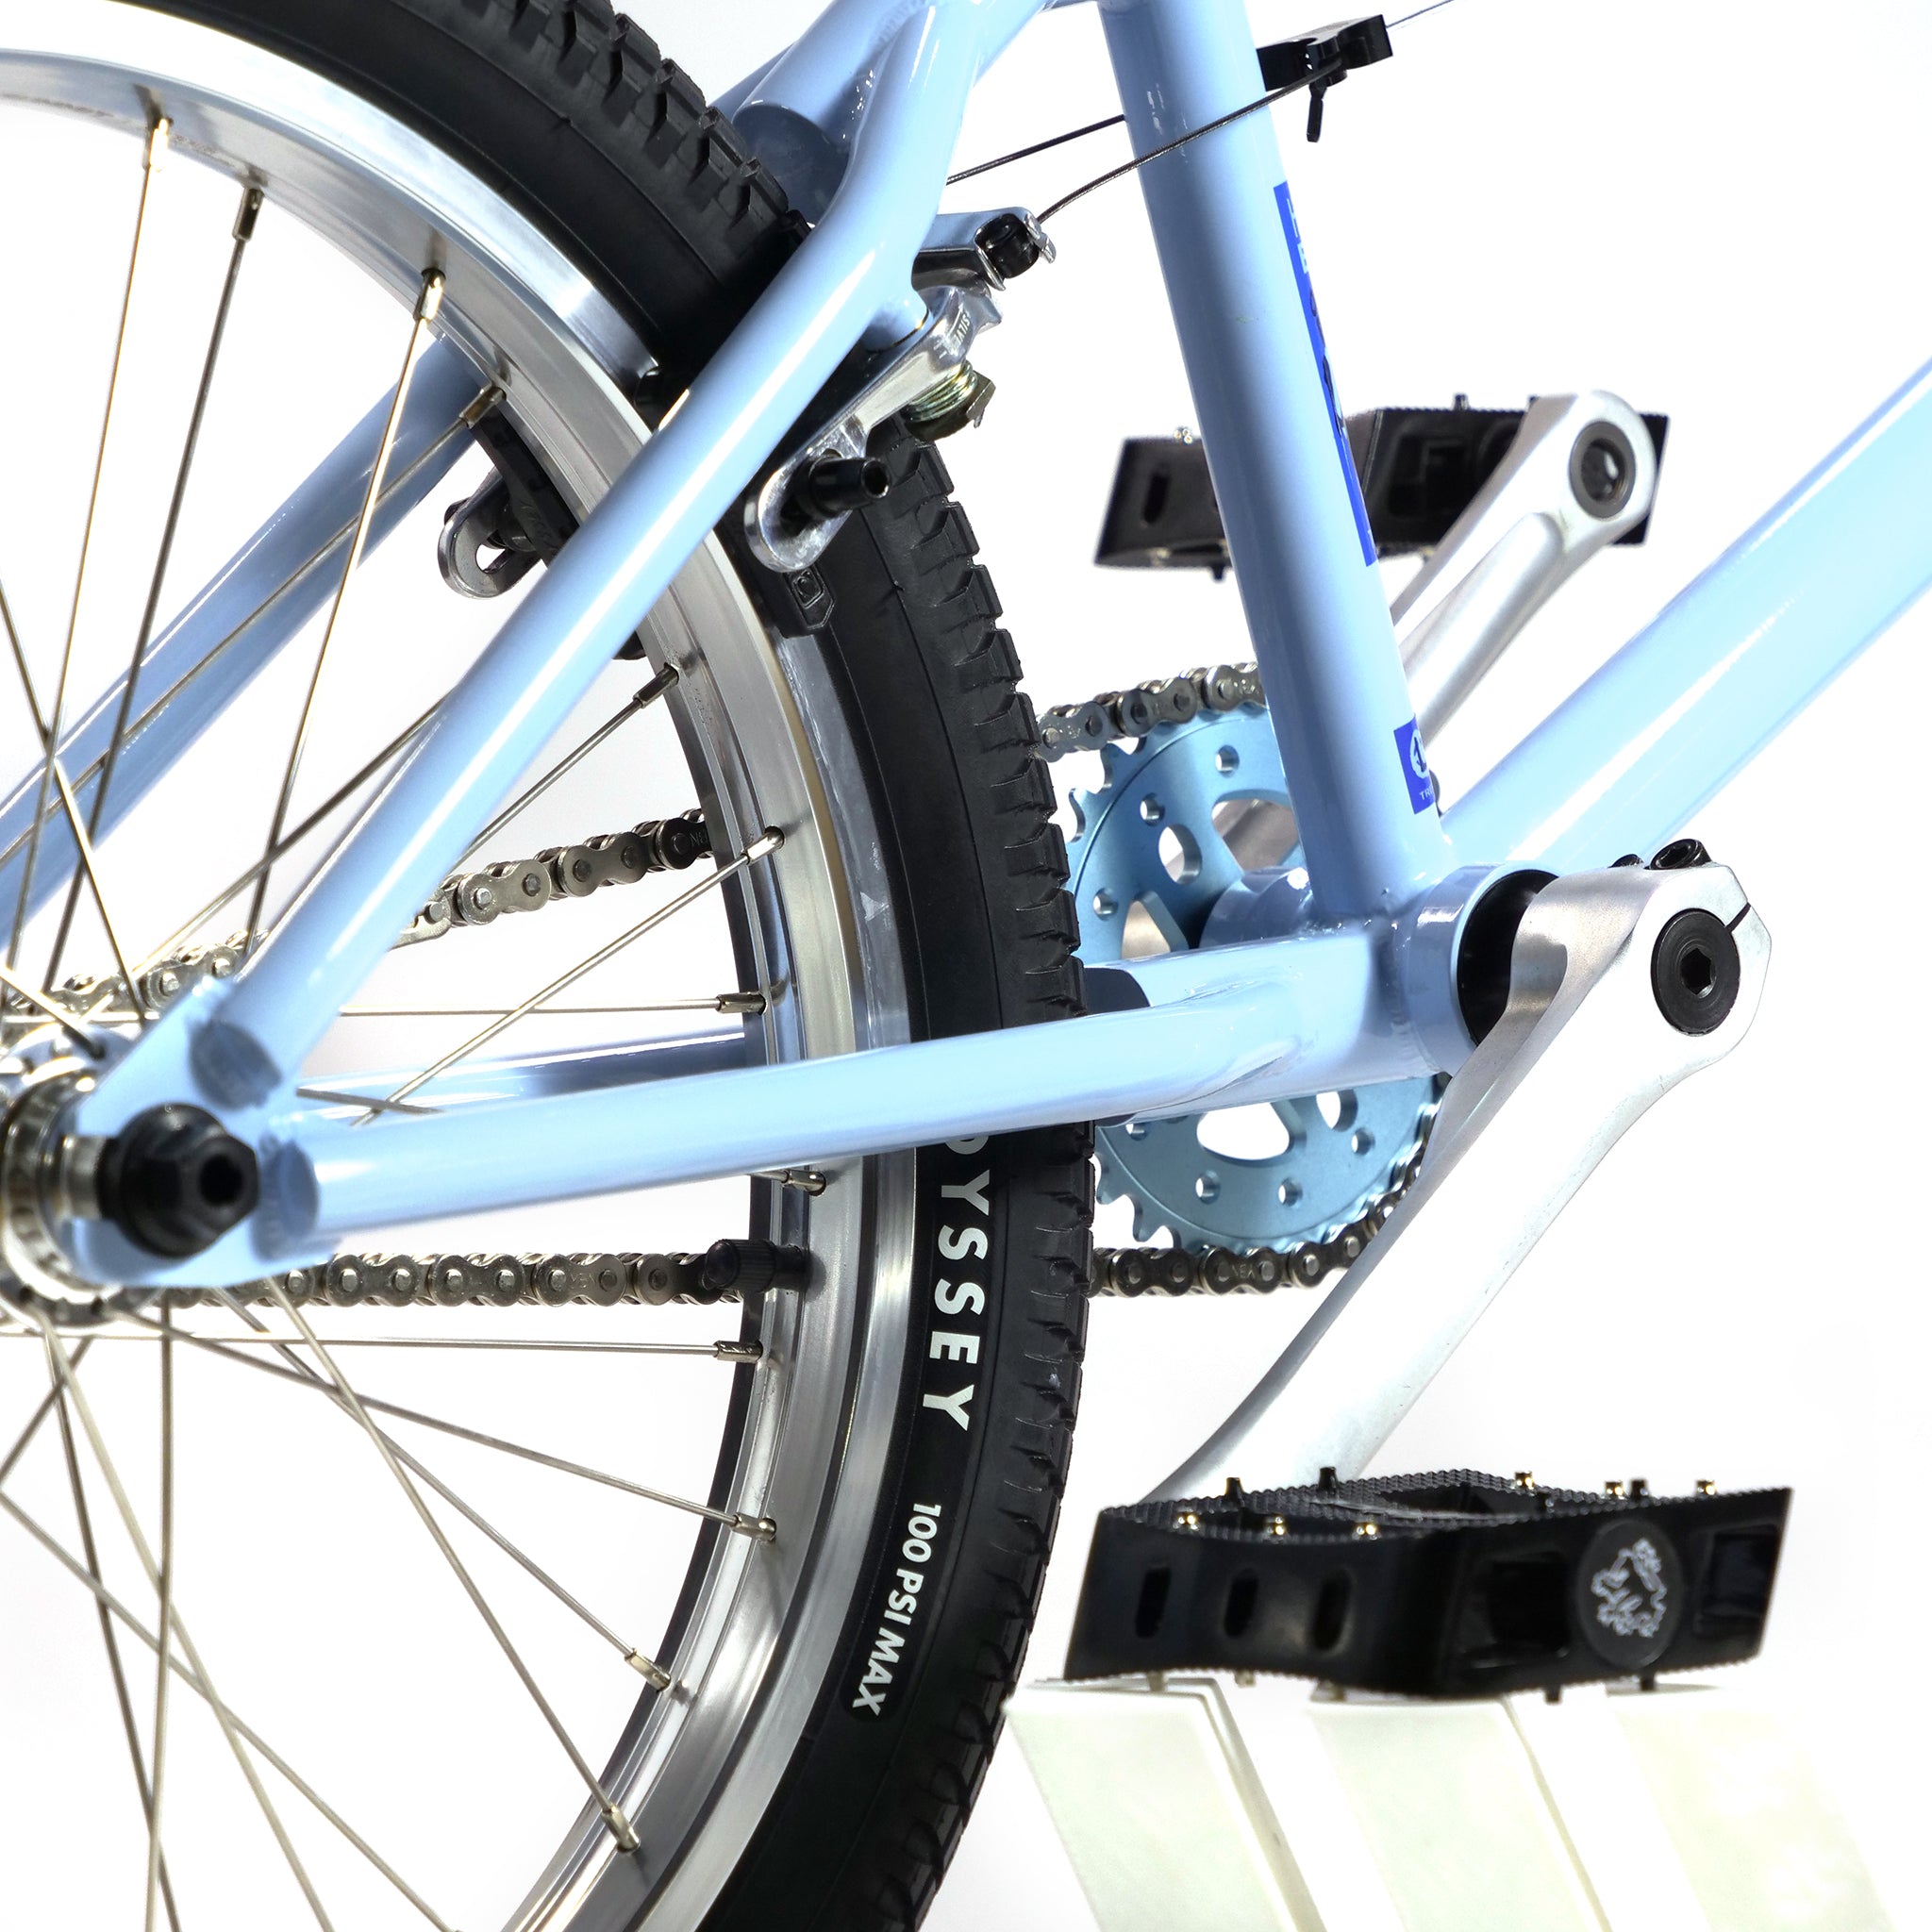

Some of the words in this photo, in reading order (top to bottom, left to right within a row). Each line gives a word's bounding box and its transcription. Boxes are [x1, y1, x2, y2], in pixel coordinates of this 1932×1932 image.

[902, 1503, 941, 1563] 100
[884, 1568, 924, 1625] PSI
[852, 1627, 906, 1717] MAX
